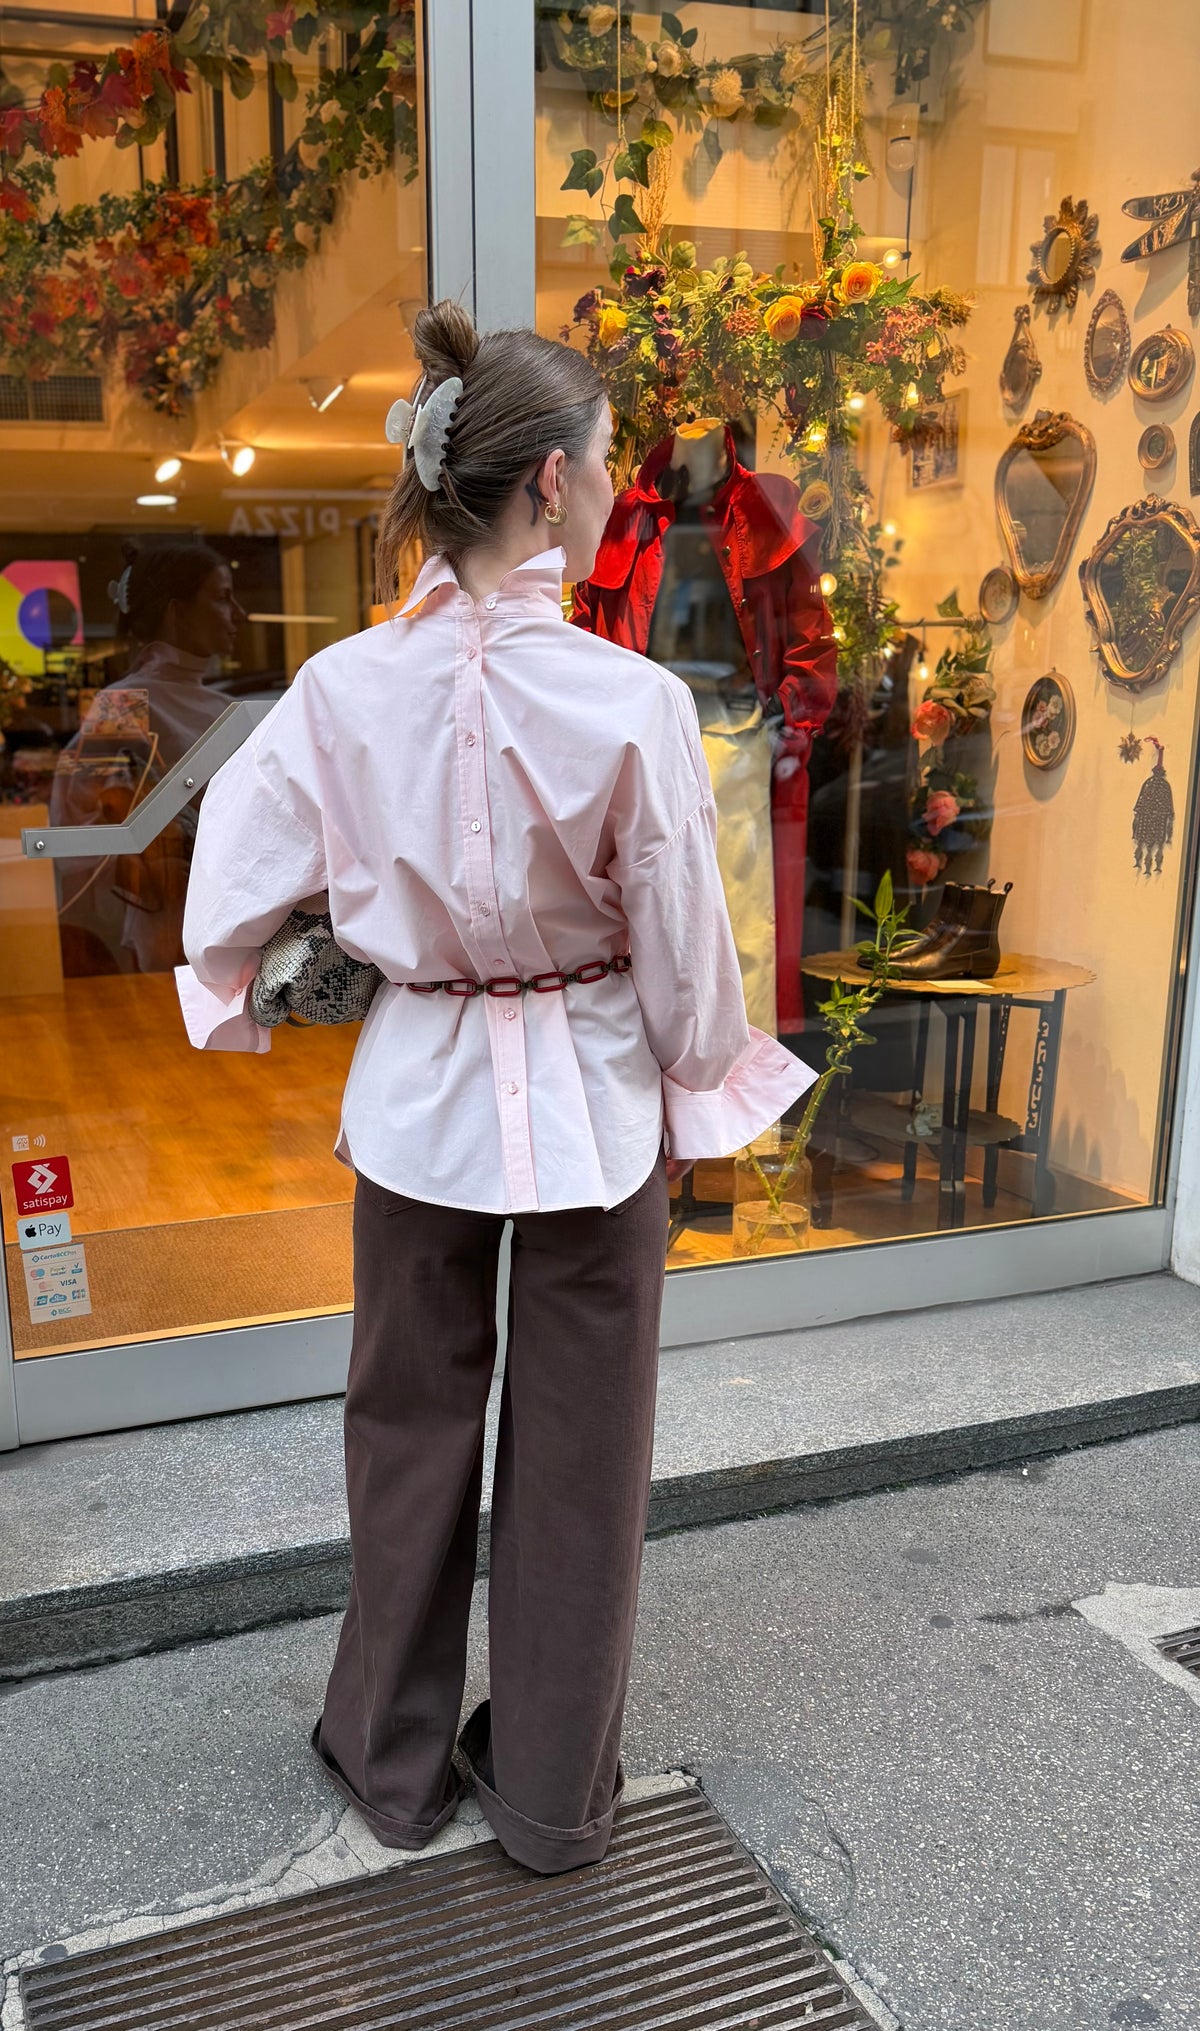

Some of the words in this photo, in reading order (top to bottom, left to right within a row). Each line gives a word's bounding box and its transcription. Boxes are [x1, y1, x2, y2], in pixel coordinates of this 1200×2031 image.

[23, 1195, 68, 1209] satispay
[38, 1223, 62, 1237] Pay
[60, 1278, 77, 1286] VISA
